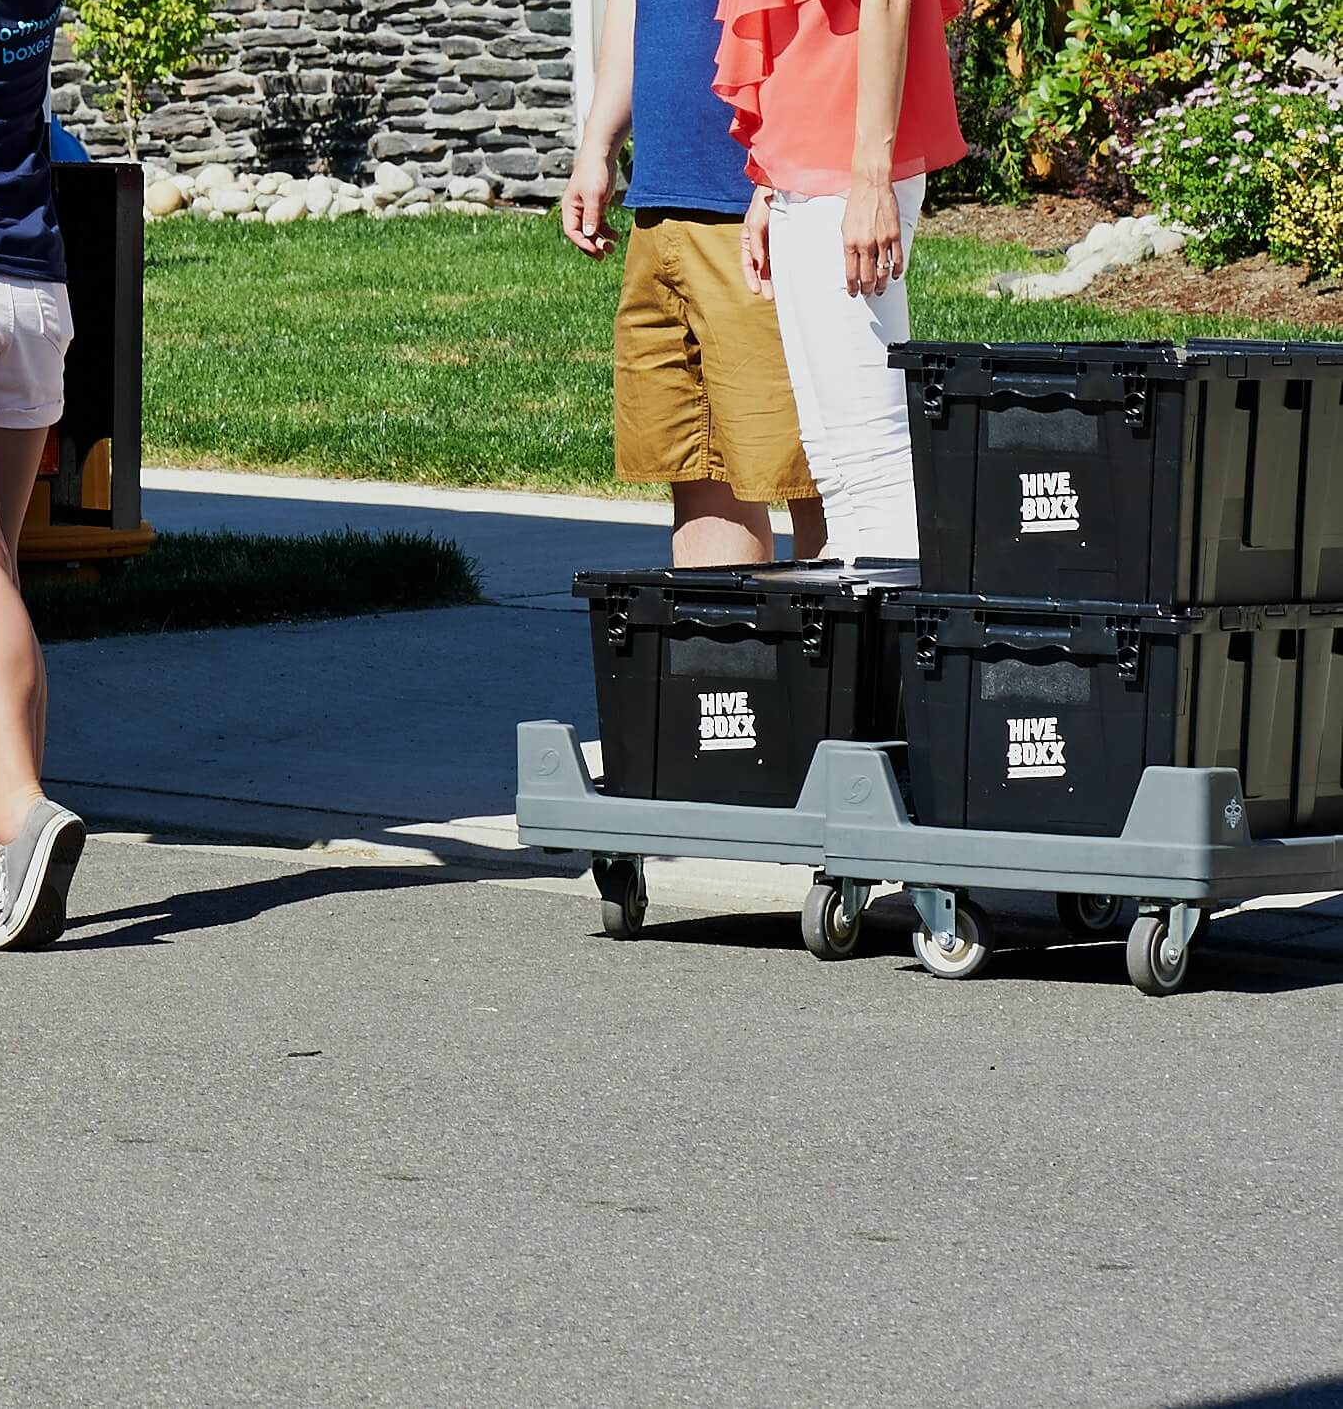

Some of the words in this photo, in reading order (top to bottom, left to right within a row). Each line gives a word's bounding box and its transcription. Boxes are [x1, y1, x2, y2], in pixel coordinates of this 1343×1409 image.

[2, 34, 52, 65] boxes
[1019, 471, 1071, 497] HIVE
[1019, 495, 1080, 521] BOXX
[697, 691, 749, 716] HIVE
[698, 714, 757, 739] BOXX
[1006, 717, 1058, 742] HIVE
[1006, 741, 1066, 766] BOXX
